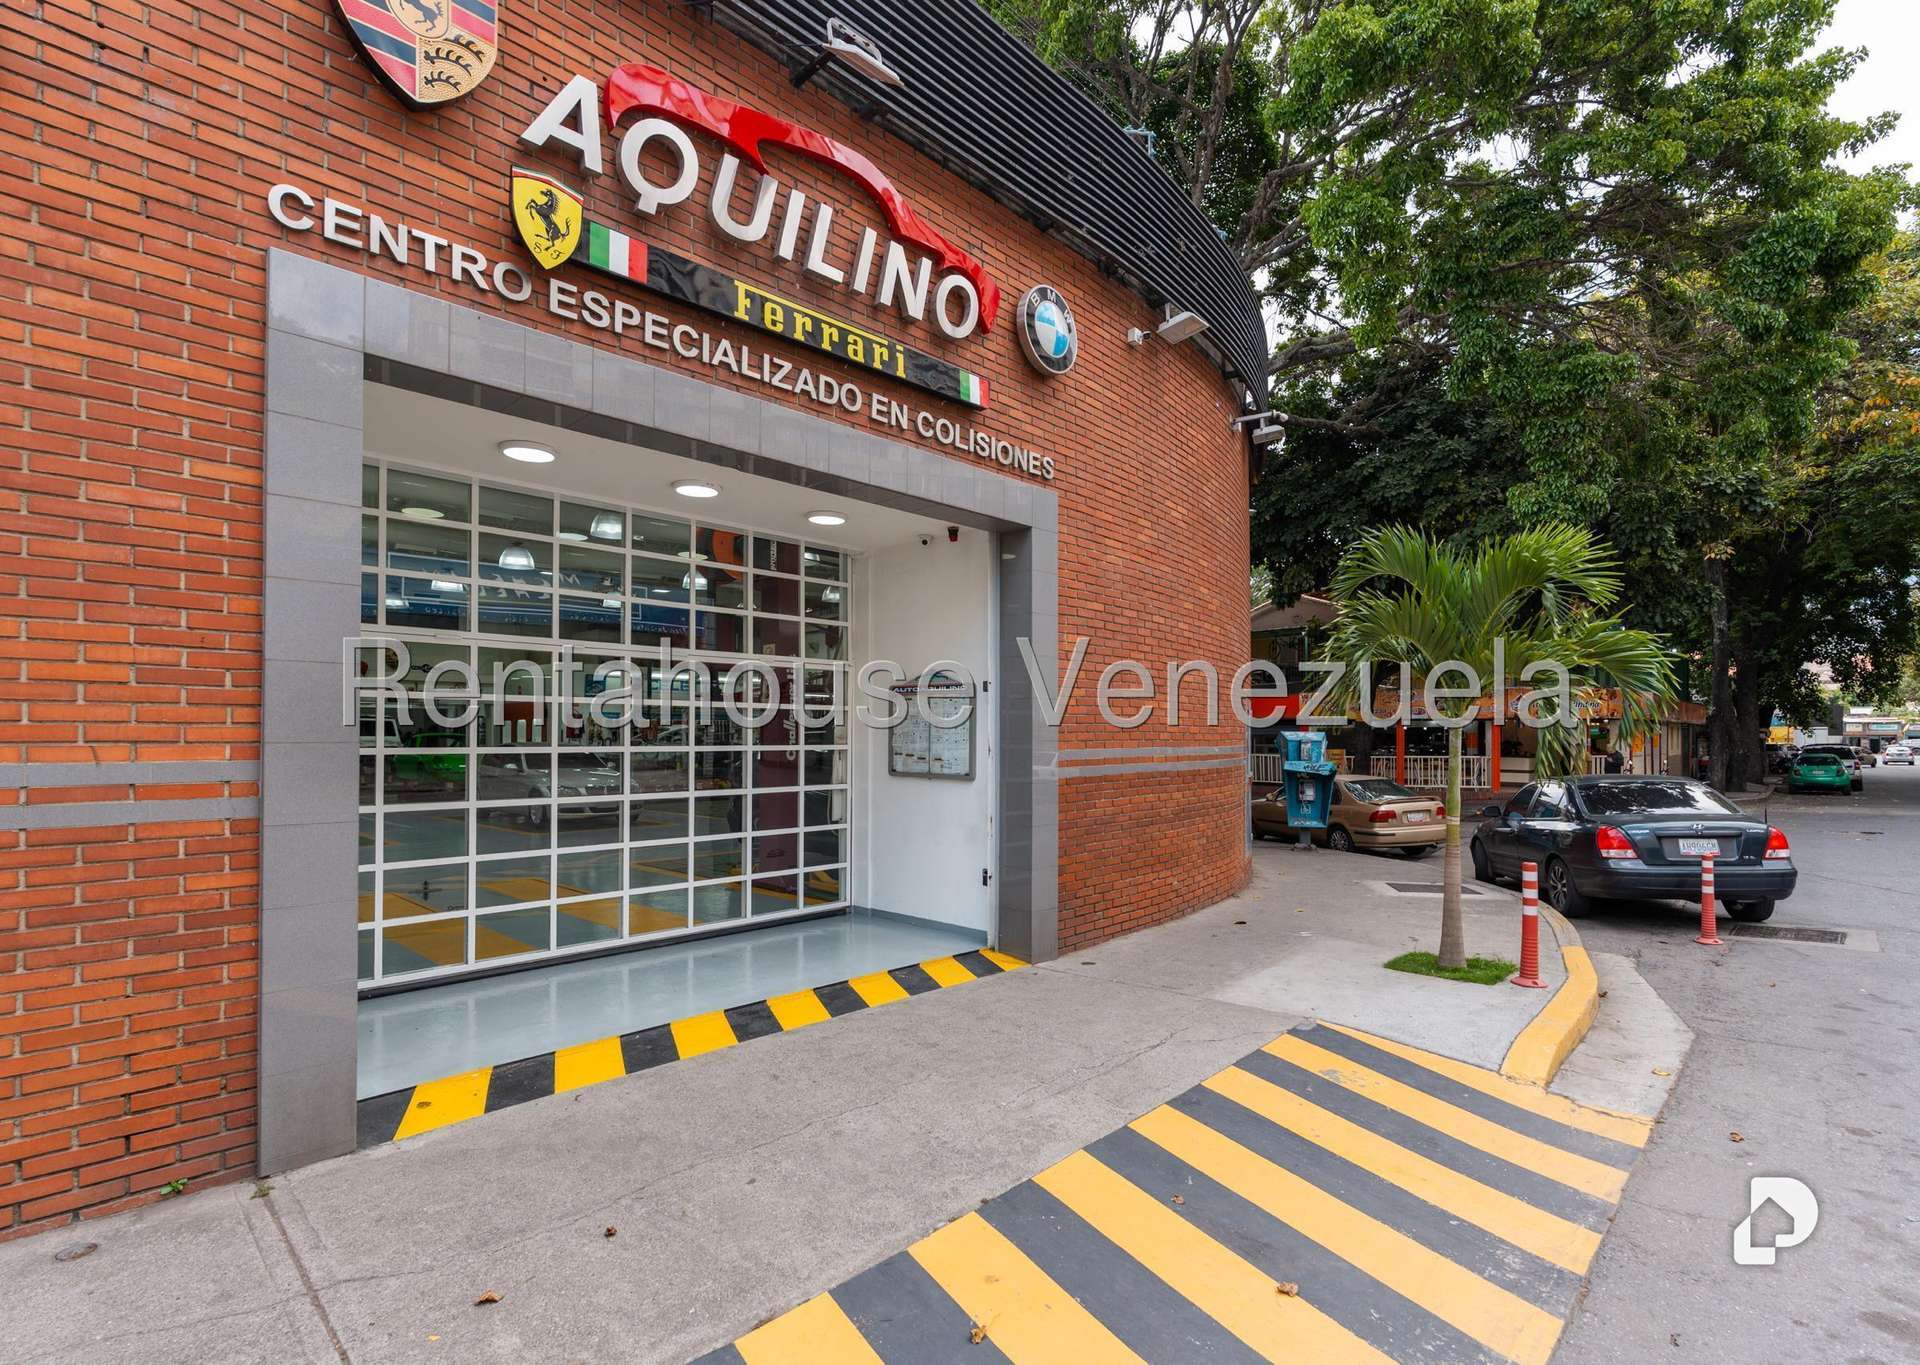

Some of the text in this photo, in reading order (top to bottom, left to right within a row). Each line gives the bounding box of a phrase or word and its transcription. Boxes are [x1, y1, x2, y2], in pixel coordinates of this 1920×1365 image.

[520, 74, 979, 340] AQUILINO
[267, 184, 1055, 480] CENTRO ESPECIALIZADO EN COLISIONES
[733, 279, 907, 380] Ferrari
[1031, 288, 1072, 325] BMW
